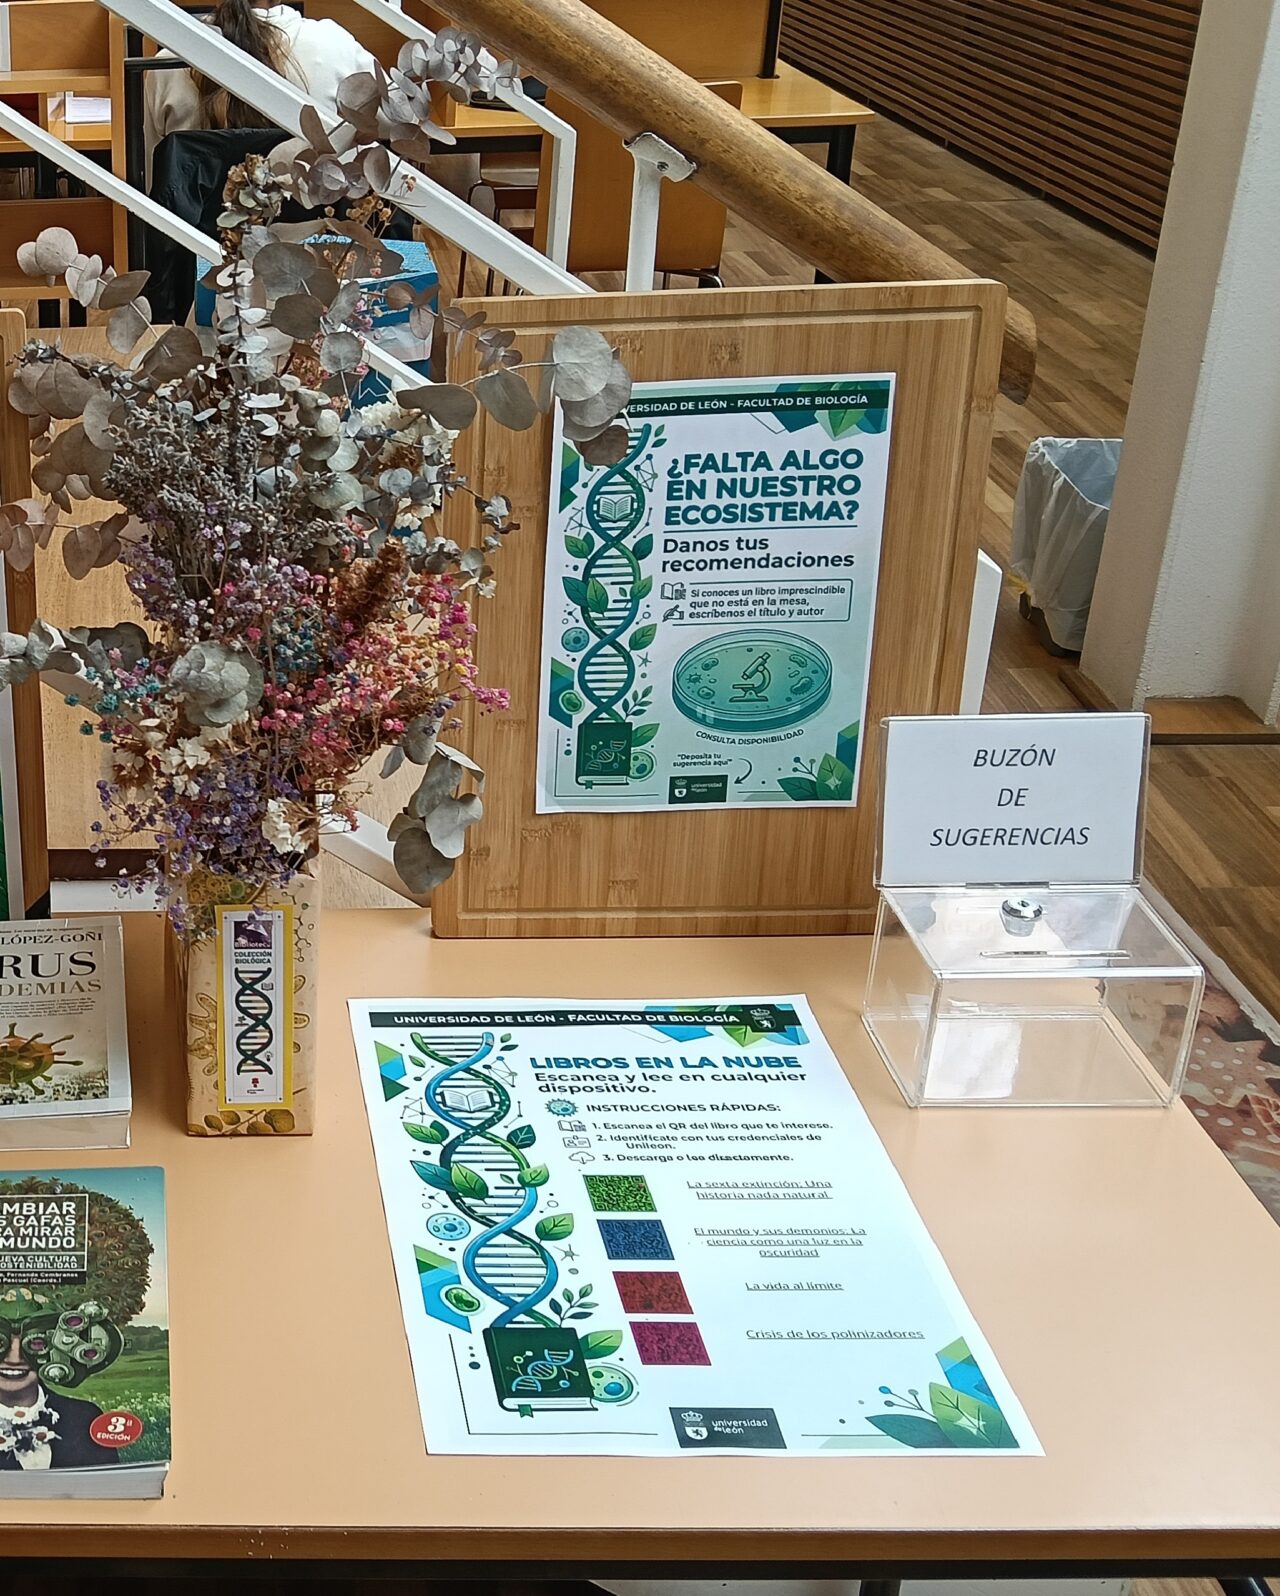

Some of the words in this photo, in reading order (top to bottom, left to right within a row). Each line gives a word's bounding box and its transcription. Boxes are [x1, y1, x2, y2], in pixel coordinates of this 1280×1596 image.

[667, 452, 776, 478] ¿FALTA
[781, 449, 864, 470] ALGO
[666, 479, 710, 501] EN
[716, 474, 861, 499] NUESTRO
[664, 500, 860, 526] ECOSISTEMA?
[662, 537, 729, 553] Danos
[736, 536, 769, 550] tus
[661, 551, 855, 573] recomendaciones
[690, 589, 700, 598] Si
[702, 588, 739, 597] conoces
[741, 588, 753, 596] un
[755, 586, 776, 596] libro
[778, 585, 846, 596] imprescindible
[696, 730, 736, 744] CONSULTA
[738, 729, 804, 745] DISPONIBILIDAD
[973, 744, 1056, 767] BUZÓN
[997, 788, 1029, 807] DE
[929, 827, 1090, 847] SUGERENCIAS
[1, 932, 103, 945] LÓPEZ-GOÑI
[530, 1057, 628, 1069] LIBROS
[636, 1056, 674, 1069] EN
[680, 1056, 716, 1068] LA
[723, 1056, 802, 1068] NUBE
[535, 1073, 620, 1082] Escanea
[624, 1075, 635, 1084] y
[642, 1072, 673, 1081] lee
[711, 1072, 807, 1083] cualquier
[538, 1083, 656, 1095] dispositivo.
[586, 1104, 707, 1112] INSTRUCCIONES
[710, 1102, 781, 1112] RÁPIDAS:
[13, 1215, 76, 1226] GAFAS
[20, 1227, 75, 1236] MIRAR
[746, 1330, 783, 1338] Crisis
[787, 1330, 803, 1338] de
[807, 1330, 828, 1338] los
[831, 1330, 924, 1340] polinizadores
[97, 1432, 130, 1440] EDICIÓN
